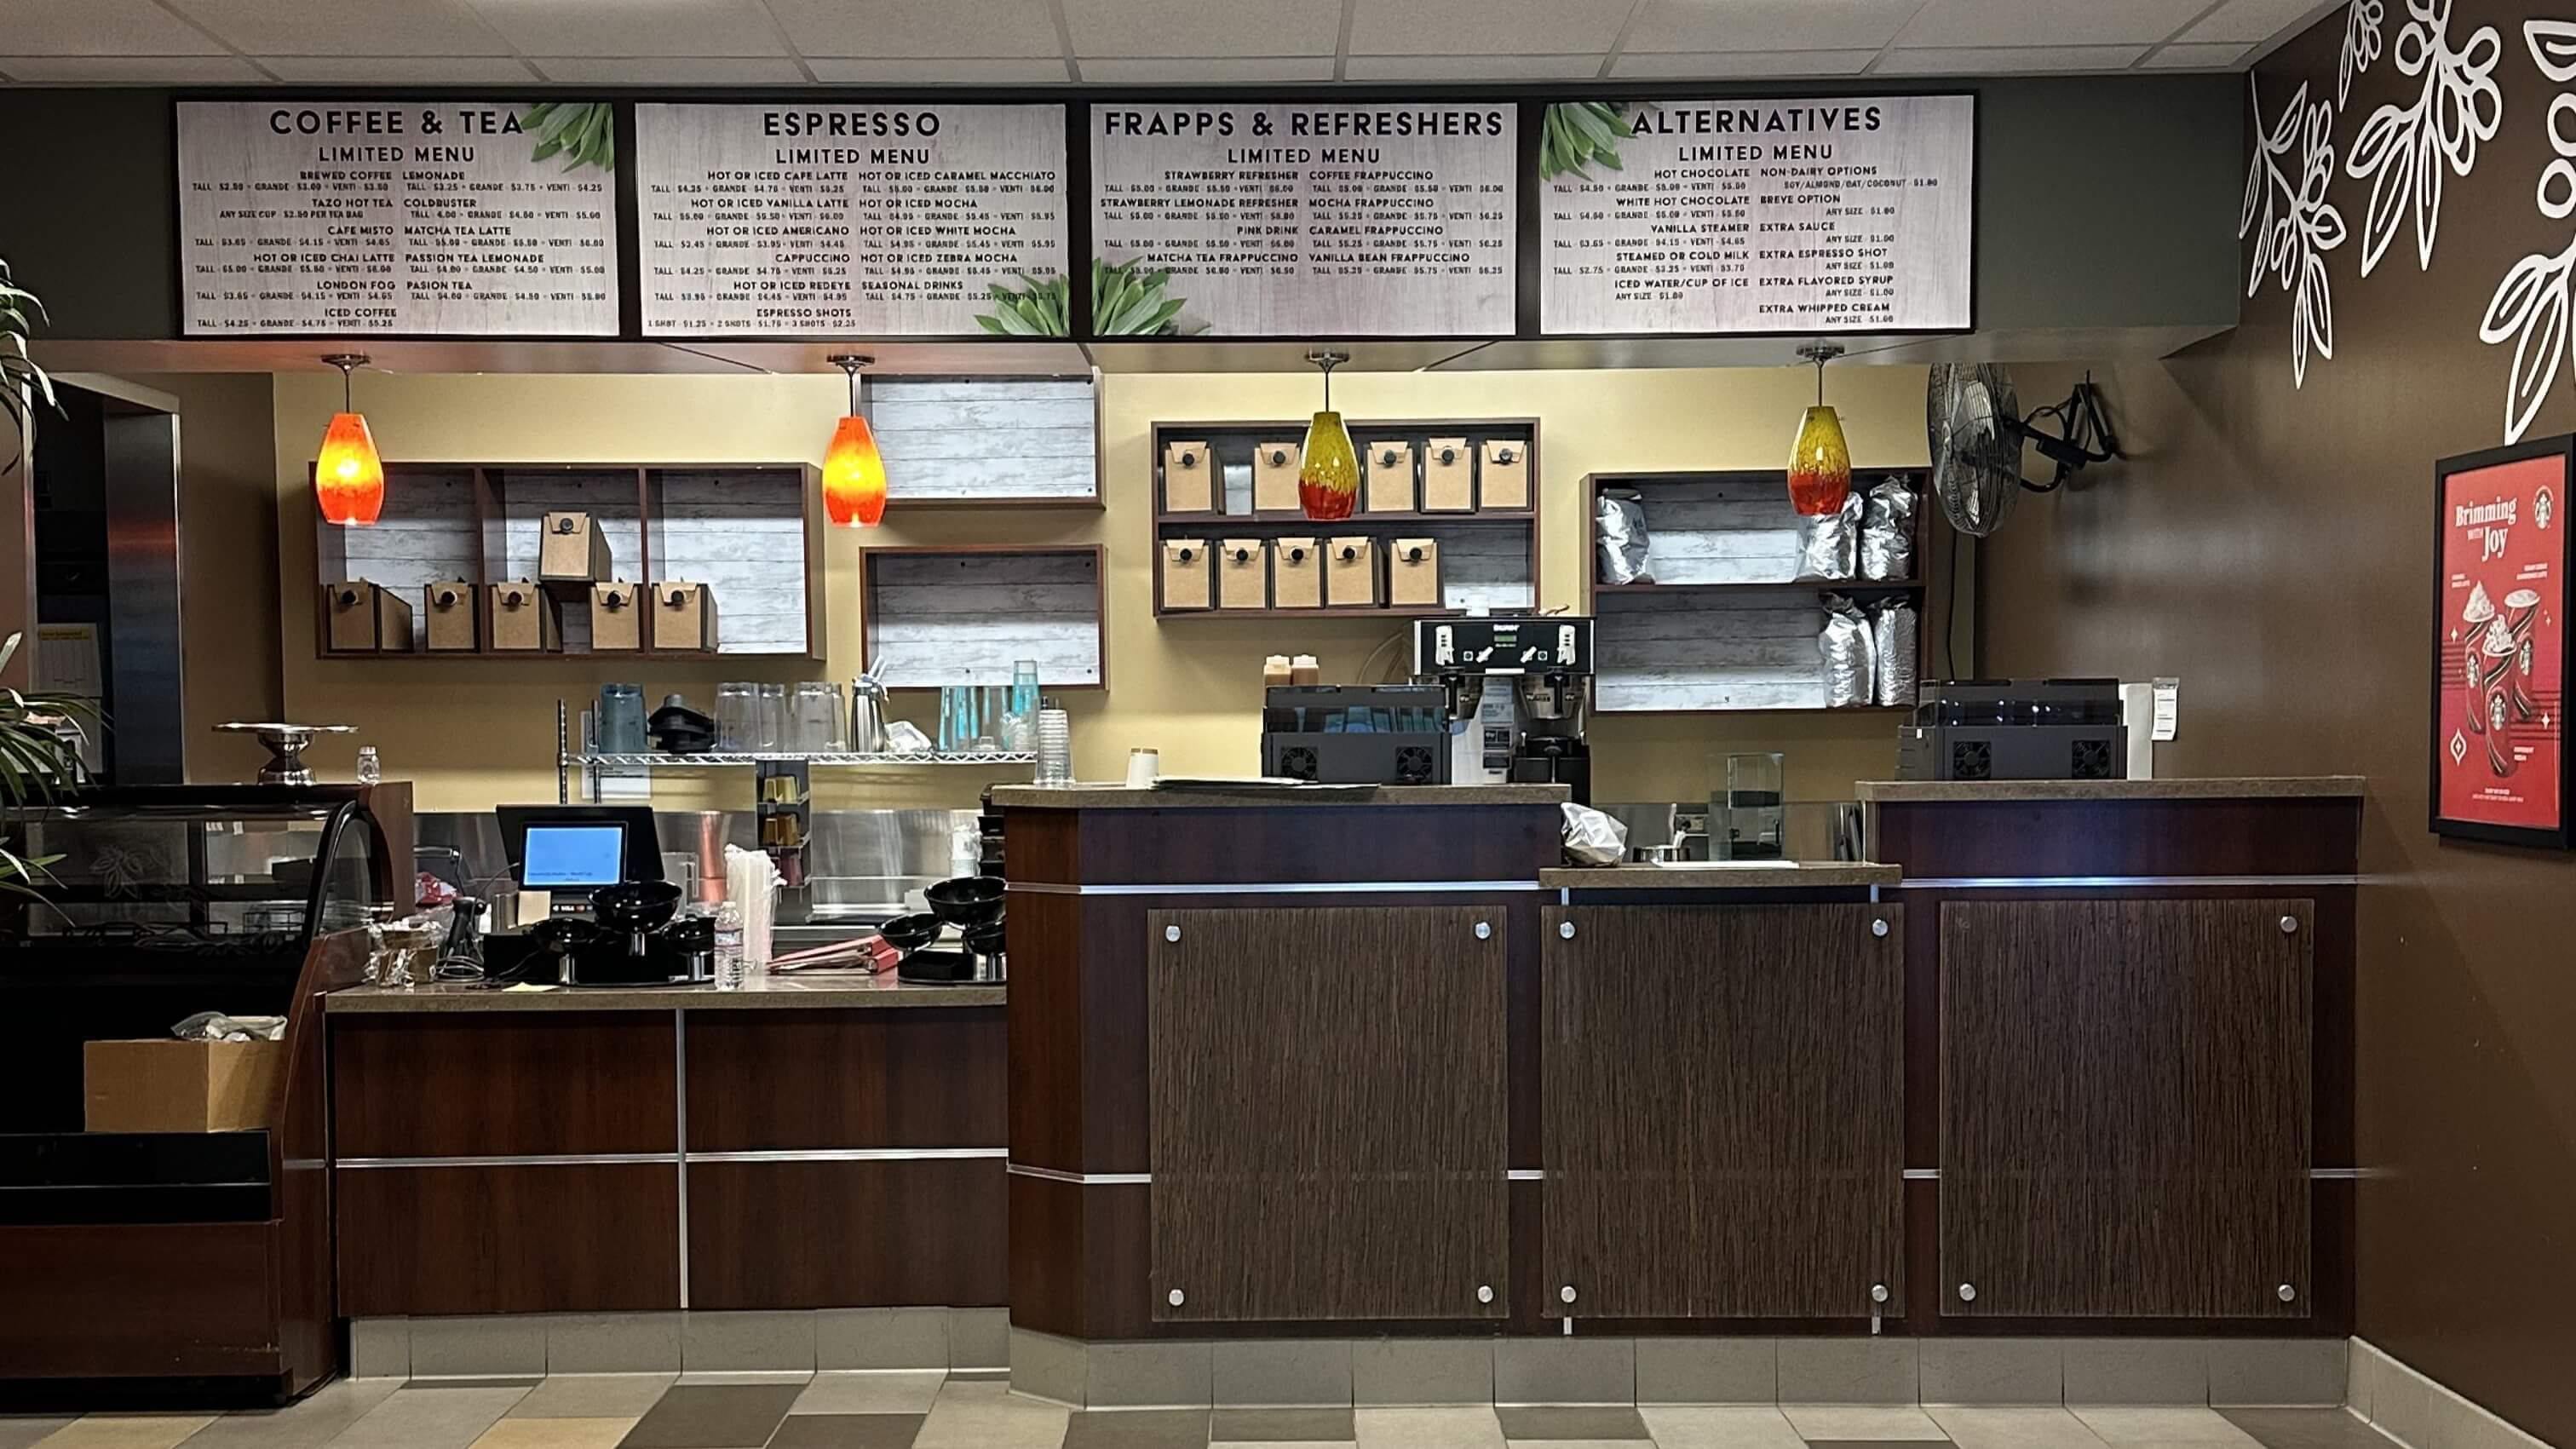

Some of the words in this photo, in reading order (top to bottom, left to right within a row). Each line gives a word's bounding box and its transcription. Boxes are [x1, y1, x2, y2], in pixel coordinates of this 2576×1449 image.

[269, 110, 404, 135] COFFEE
[421, 110, 443, 135] &
[459, 110, 523, 135] TEA
[764, 112, 940, 136] ESPRESSO
[1106, 112, 1233, 136] FRAPPS
[1252, 112, 1273, 136] &
[1291, 112, 1502, 135] REFRESHERS
[1630, 106, 1881, 135] ALTERNATIVES
[319, 147, 404, 162] LIMITED
[415, 147, 474, 162] MENU
[776, 149, 860, 164] LIMITED
[871, 149, 929, 164] MENU
[1228, 148, 1310, 164] LIMITED
[1322, 148, 1379, 164] MENU
[1679, 146, 1762, 161] LIMITED
[1774, 145, 1831, 159] MENU
[300, 171, 346, 180] BREWED
[349, 171, 392, 181] COFFEE
[402, 171, 464, 181] LEMONADE
[708, 171, 731, 180] HOT
[734, 171, 750, 180] OR
[755, 171, 780, 181] ICED
[816, 171, 848, 181] LATTE
[859, 172, 882, 181] HOT
[885, 171, 901, 181] OR
[905, 172, 930, 181] ICED
[934, 172, 986, 181] CARAMEL
[990, 171, 1055, 181] MACCHIATO
[1164, 171, 1234, 180] STRAWBERRY
[1239, 171, 1298, 180] REFRESHER
[1309, 170, 1350, 181] COFFEE
[1354, 171, 1433, 180] FRAPPUCCINO
[1654, 170, 1677, 179] HOT
[1681, 169, 1750, 178] CHOCOLATE
[1761, 167, 1824, 177] NON-DAIRY
[1827, 165, 1877, 175] OPTIONS
[406, 183, 426, 192] TALL
[469, 183, 503, 192] GRANDE
[547, 183, 570, 192] VENTI
[312, 198, 342, 208] TAZO
[346, 198, 369, 208] HOT
[372, 198, 393, 207] TEA
[403, 198, 476, 208] COLDBUSTER
[691, 199, 714, 208] HOT
[717, 198, 733, 208] OR
[738, 198, 763, 208] ICED
[767, 199, 814, 208] VANILLA
[817, 198, 848, 208] LATTE
[860, 199, 882, 208] HOT
[886, 198, 901, 208] OR
[906, 199, 931, 208] ICED
[935, 199, 977, 208] MOCHA
[1101, 198, 1170, 207] STRAWBERRY
[1175, 198, 1235, 207] LEMONADE
[1239, 198, 1298, 207] REFRESHER
[1308, 198, 1351, 208] MOCHA
[1355, 198, 1434, 207] FRAPPUCCINO
[1616, 198, 1649, 206] WHITE
[1654, 198, 1676, 206] HOT
[1681, 196, 1749, 206] CHOCOLATE
[1797, 194, 1840, 204] OPTION
[359, 226, 394, 235] MISTO
[405, 226, 451, 235] MATCHA
[455, 227, 475, 235] TEA
[479, 227, 510, 235] LATTE
[707, 227, 729, 235] HOT
[733, 227, 749, 235] OR
[753, 227, 779, 235] ICED
[782, 227, 849, 235] AMERICANO
[860, 227, 883, 235] HOT
[886, 227, 902, 235] OR
[906, 227, 932, 235] ICED
[935, 227, 969, 235] WHITE
[974, 227, 1015, 235] MOCHA
[1237, 227, 1262, 235] PINK
[1266, 226, 1298, 235] DRINK
[1309, 226, 1360, 235] CARAMEL
[1365, 226, 1443, 235] FRAPPUCCINO
[1701, 223, 1750, 233] STEAMER
[1760, 223, 1795, 232] EXTRA
[1799, 221, 1834, 231] SAUCE
[254, 254, 277, 262] HOT
[280, 254, 297, 262] OR
[301, 254, 326, 262] ICED
[331, 254, 359, 262] CHAI
[363, 254, 394, 262] LATTE
[405, 254, 454, 262] PASSION
[457, 254, 478, 262] TEA
[482, 254, 543, 262] LEMONADE
[775, 254, 850, 262] CAPPUCCINO
[860, 254, 883, 262] HOT
[887, 254, 903, 262] OR
[907, 254, 932, 262] ICED
[937, 254, 971, 262] ZEBRA
[975, 254, 1017, 262] MOCHA
[1147, 254, 1193, 262] MATCHA
[1196, 254, 1216, 262] TEA
[1220, 254, 1298, 262] FRAPPUCCINO
[1308, 254, 1354, 262] VANILLA
[1359, 253, 1387, 262] BEAN
[1391, 253, 1469, 262] FRAPPUCCINO
[1617, 252, 1665, 261] STEAMED
[1670, 252, 1685, 261] OR
[1689, 251, 1721, 260] COLD
[1724, 250, 1749, 259] MILK
[1759, 250, 1794, 259] EXTRA
[1798, 249, 1854, 258] ESPRESSO
[1858, 249, 1887, 257] SHOT
[317, 281, 367, 290] LONDON
[371, 281, 395, 290] FOG
[452, 281, 472, 290] TEA
[733, 281, 756, 290] HOT
[760, 281, 776, 290] OR
[780, 281, 806, 290] ICED
[809, 281, 851, 290] REDEYE
[862, 281, 920, 290] SEASONAL
[924, 281, 963, 290] DRINKS
[1615, 279, 1641, 289] ICED
[1644, 279, 1708, 288] WATER/CUP
[1712, 279, 1727, 287] OF
[1731, 278, 1748, 287] ICE
[1759, 278, 1794, 286] EXTRA
[1798, 276, 1854, 285] FLAVORED
[1859, 275, 1893, 285] SYRUP
[325, 308, 351, 317] ICED
[354, 308, 397, 317] COFFEE
[756, 308, 812, 317] ESPRESSO
[816, 308, 851, 317] SHOTS
[1759, 305, 1794, 313] EXTRA
[1797, 303, 1848, 313] WHIPPED
[1851, 303, 1889, 312] CREAM
[2455, 496, 2517, 526] Brimming
[2481, 526, 2509, 562] Joy
